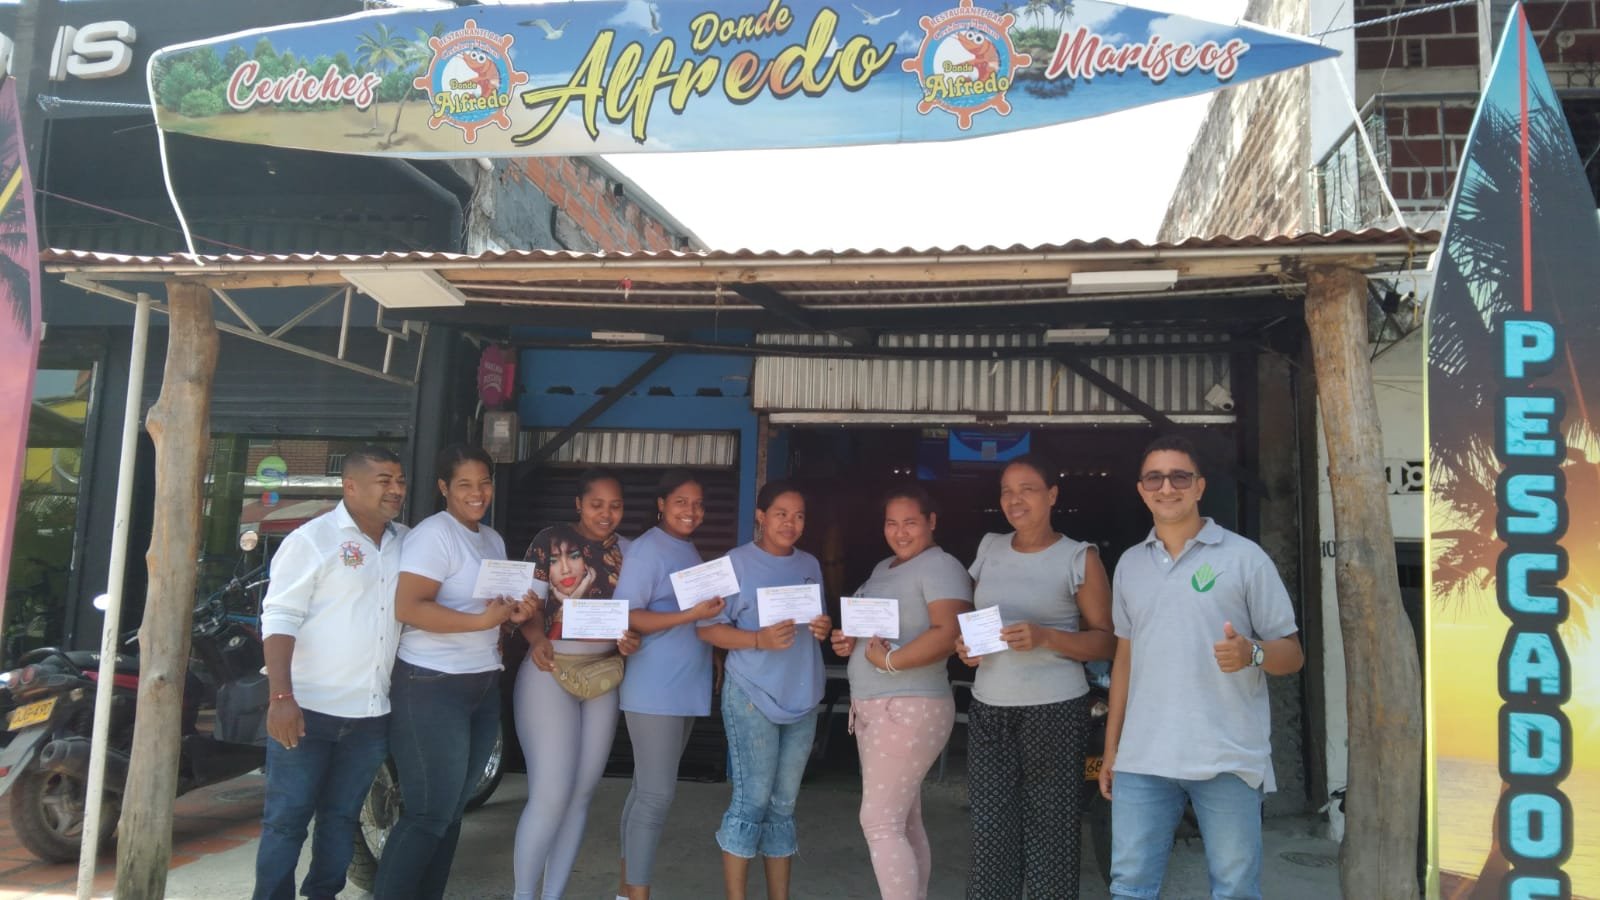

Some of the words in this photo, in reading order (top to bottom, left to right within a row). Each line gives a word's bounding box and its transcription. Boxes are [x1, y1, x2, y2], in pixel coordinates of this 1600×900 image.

[691, 0, 793, 51] Donde
[943, 60, 974, 73] Donde
[1046, 27, 1249, 82] Mariscos
[227, 60, 382, 111] Ceviches
[449, 79, 478, 90] Donde
[511, 6, 897, 146] Alfredo
[924, 71, 1010, 102] Alfredo
[434, 89, 510, 118] Alfredo
